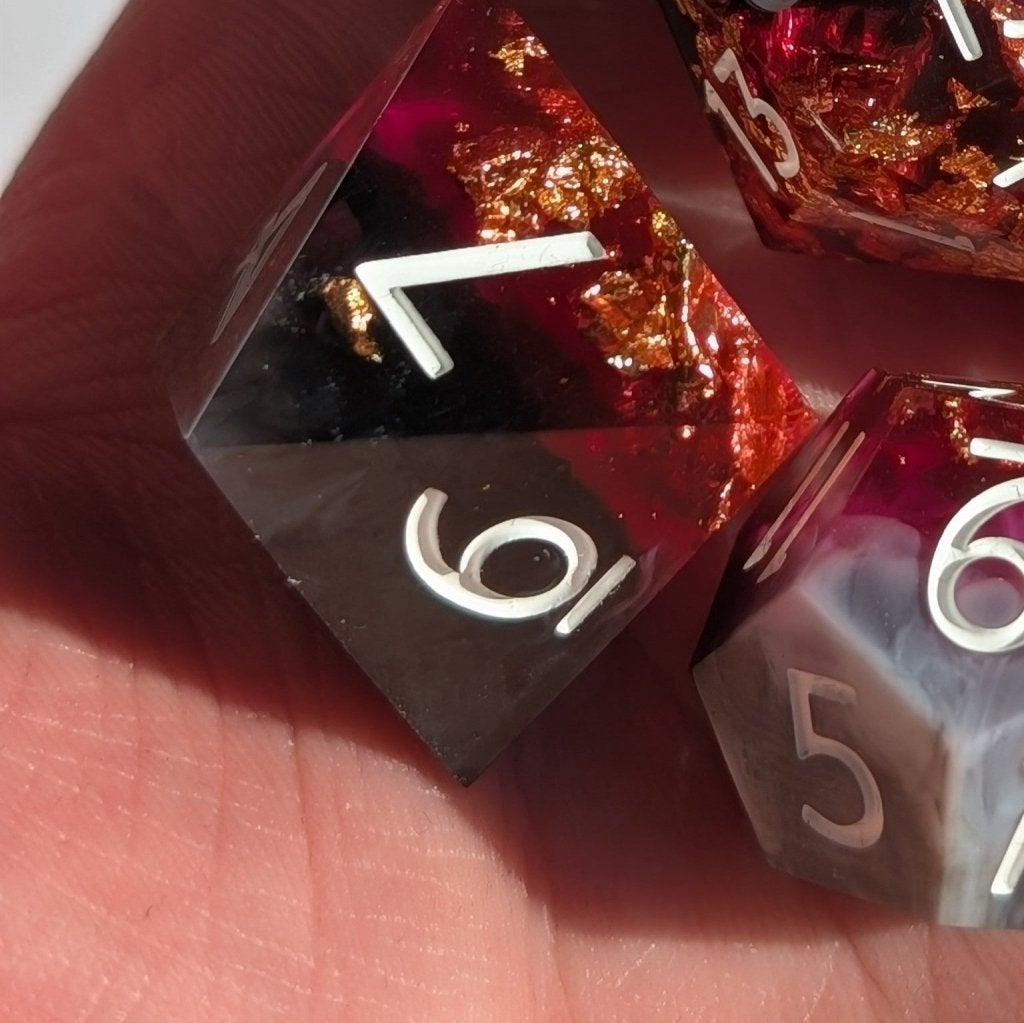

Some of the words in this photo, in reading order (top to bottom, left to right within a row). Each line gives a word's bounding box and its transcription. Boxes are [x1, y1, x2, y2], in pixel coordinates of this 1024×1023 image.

[703, 48, 801, 193] 13
[354, 231, 607, 379] 7
[788, 668, 884, 848] 5
